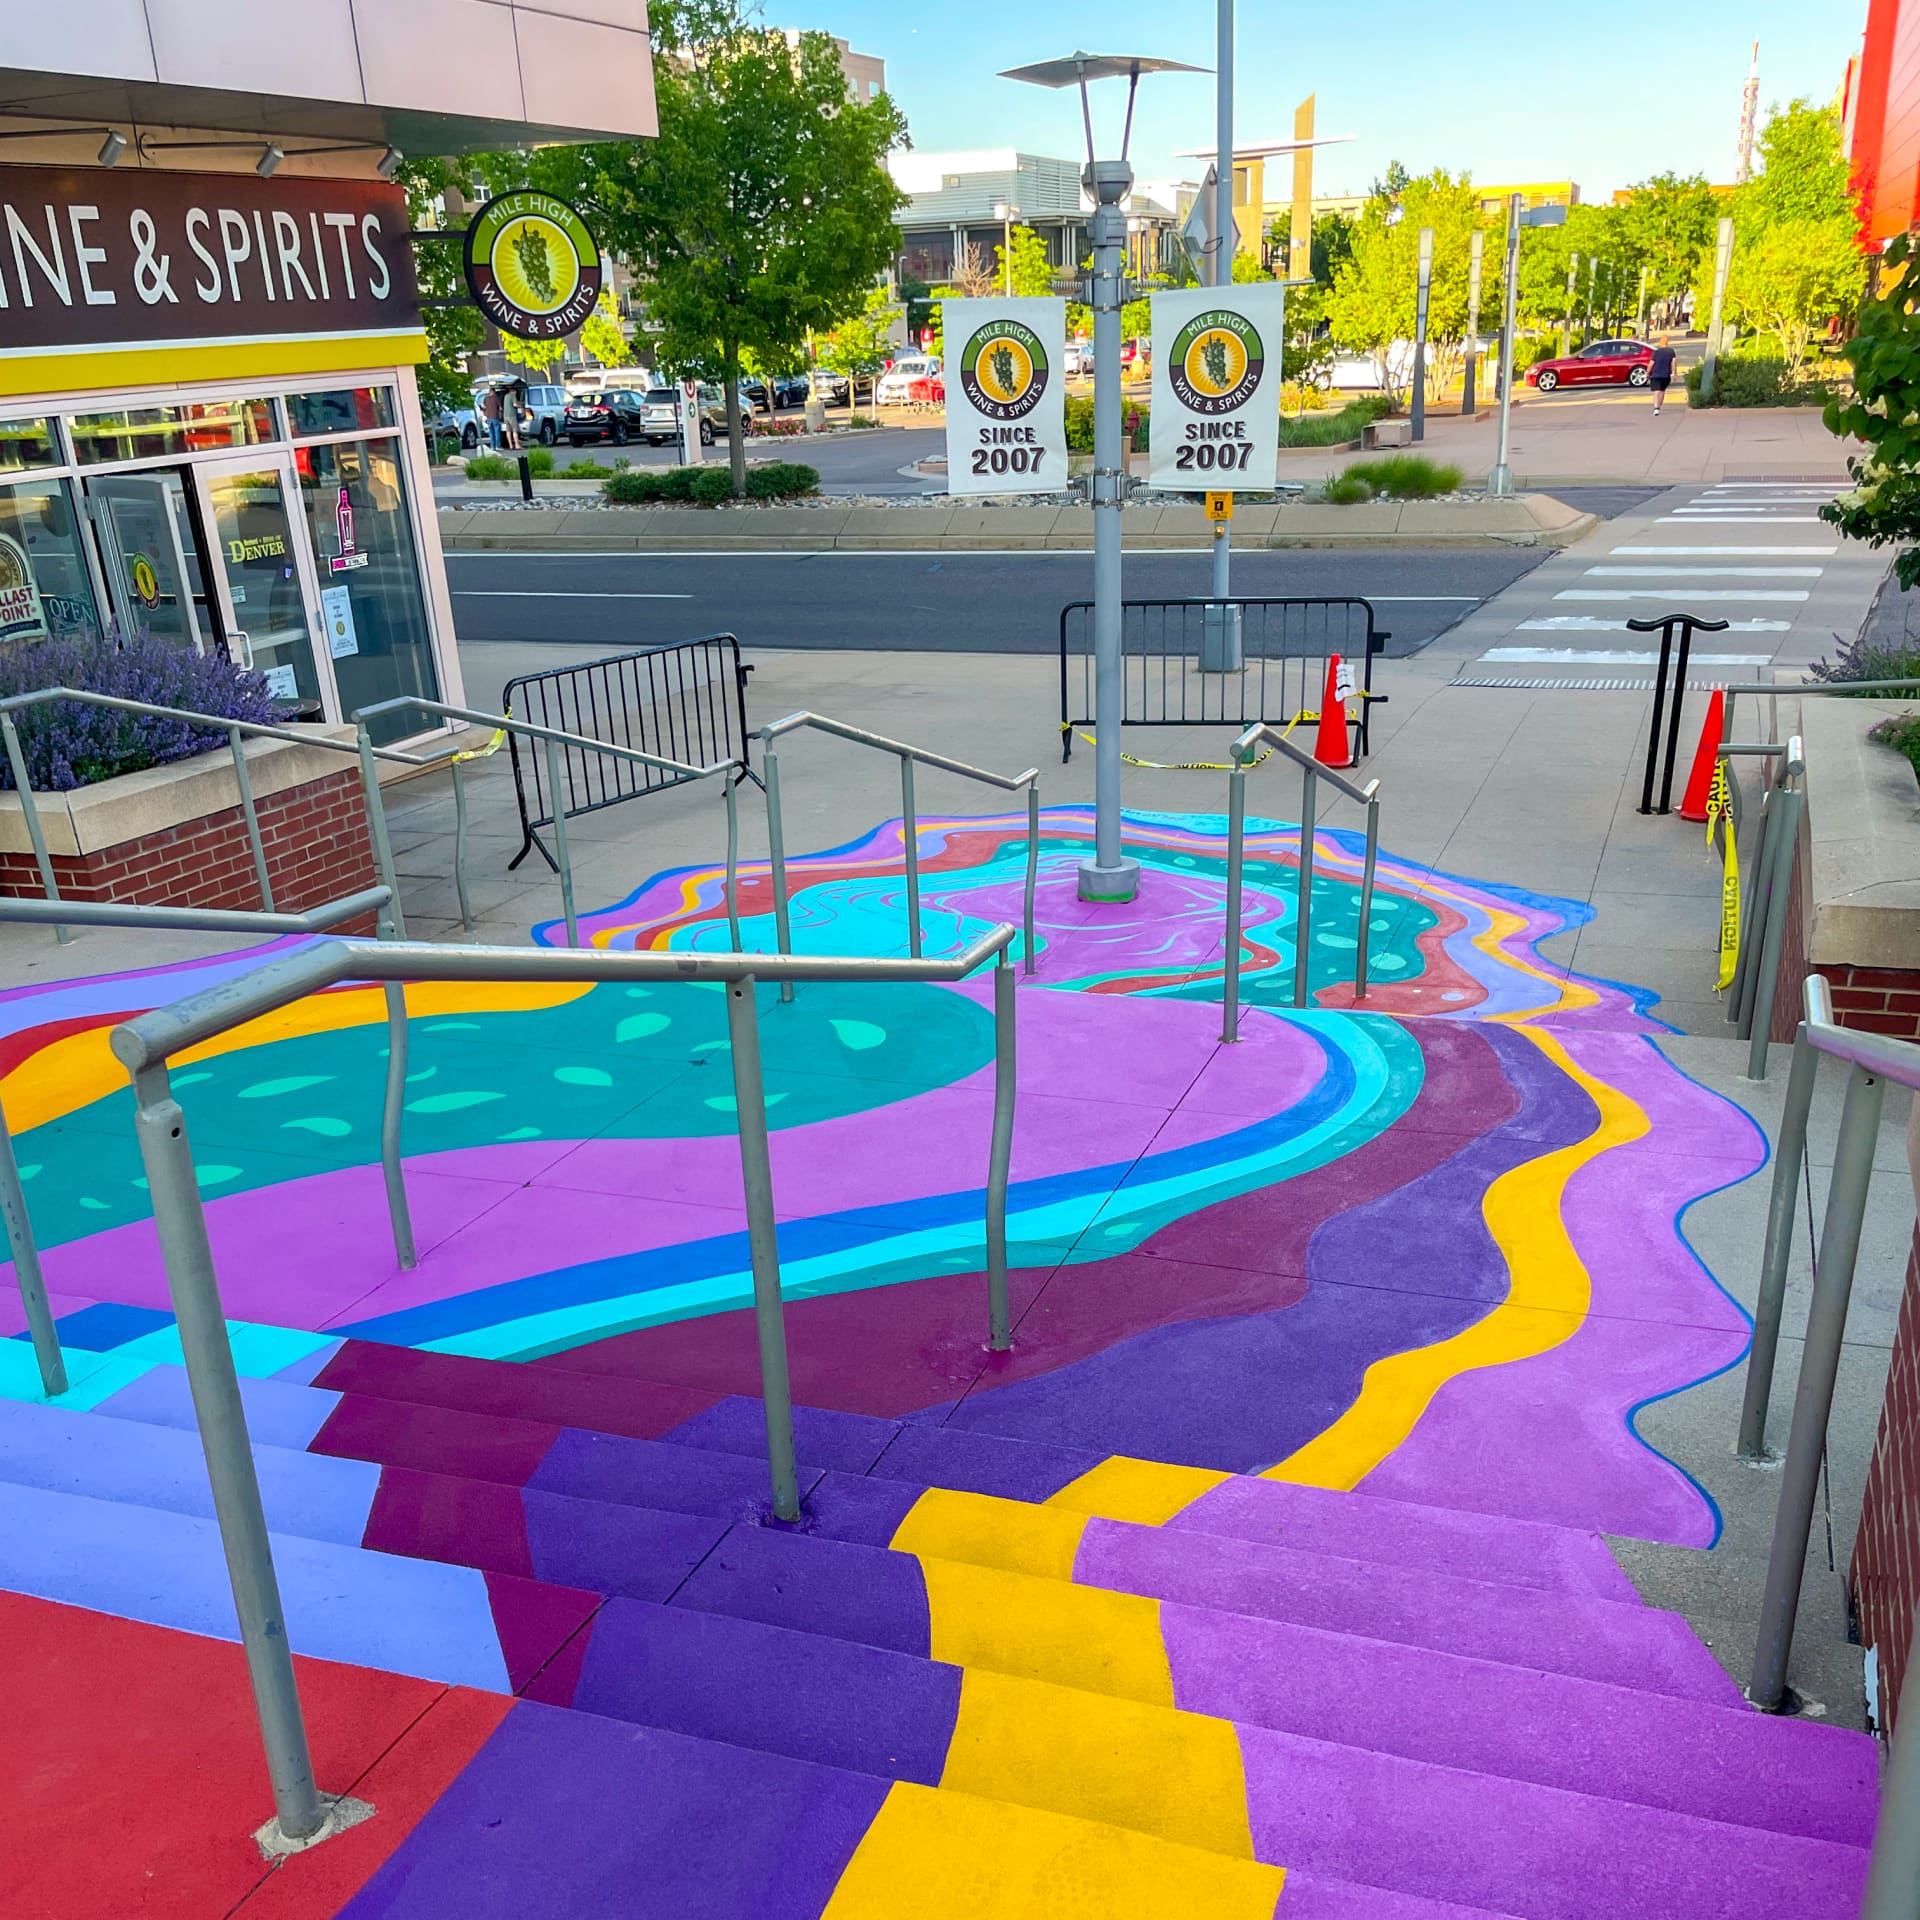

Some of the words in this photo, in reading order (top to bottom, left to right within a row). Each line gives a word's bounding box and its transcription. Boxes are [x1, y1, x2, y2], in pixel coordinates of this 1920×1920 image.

[488, 197, 524, 225] MILE
[530, 196, 574, 226] HIGH
[130, 208, 180, 305] &
[185, 207, 391, 304] SPIRITS
[482, 283, 523, 329] WINE
[528, 319, 540, 334] &
[545, 284, 594, 333] SPIRITS
[976, 323, 1001, 343] MILE
[1004, 323, 1034, 346] HIGH
[1186, 314, 1214, 336] MILE
[1217, 313, 1250, 335] HIGH
[967, 382, 994, 414] WINE
[996, 406, 1005, 417] &
[1009, 382, 1042, 417] SPIRITS
[1175, 376, 1202, 409] WINE
[1205, 401, 1214, 411] &
[1218, 373, 1258, 411] SPIRITS
[979, 427, 1037, 445] SINCE
[1185, 421, 1247, 441] SINCE
[971, 447, 1046, 476] 2007
[1175, 442, 1254, 471] 2007
[228, 540, 285, 563] DENVER
[0, 604, 30, 622] OINT
[49, 598, 95, 625] OPEN
